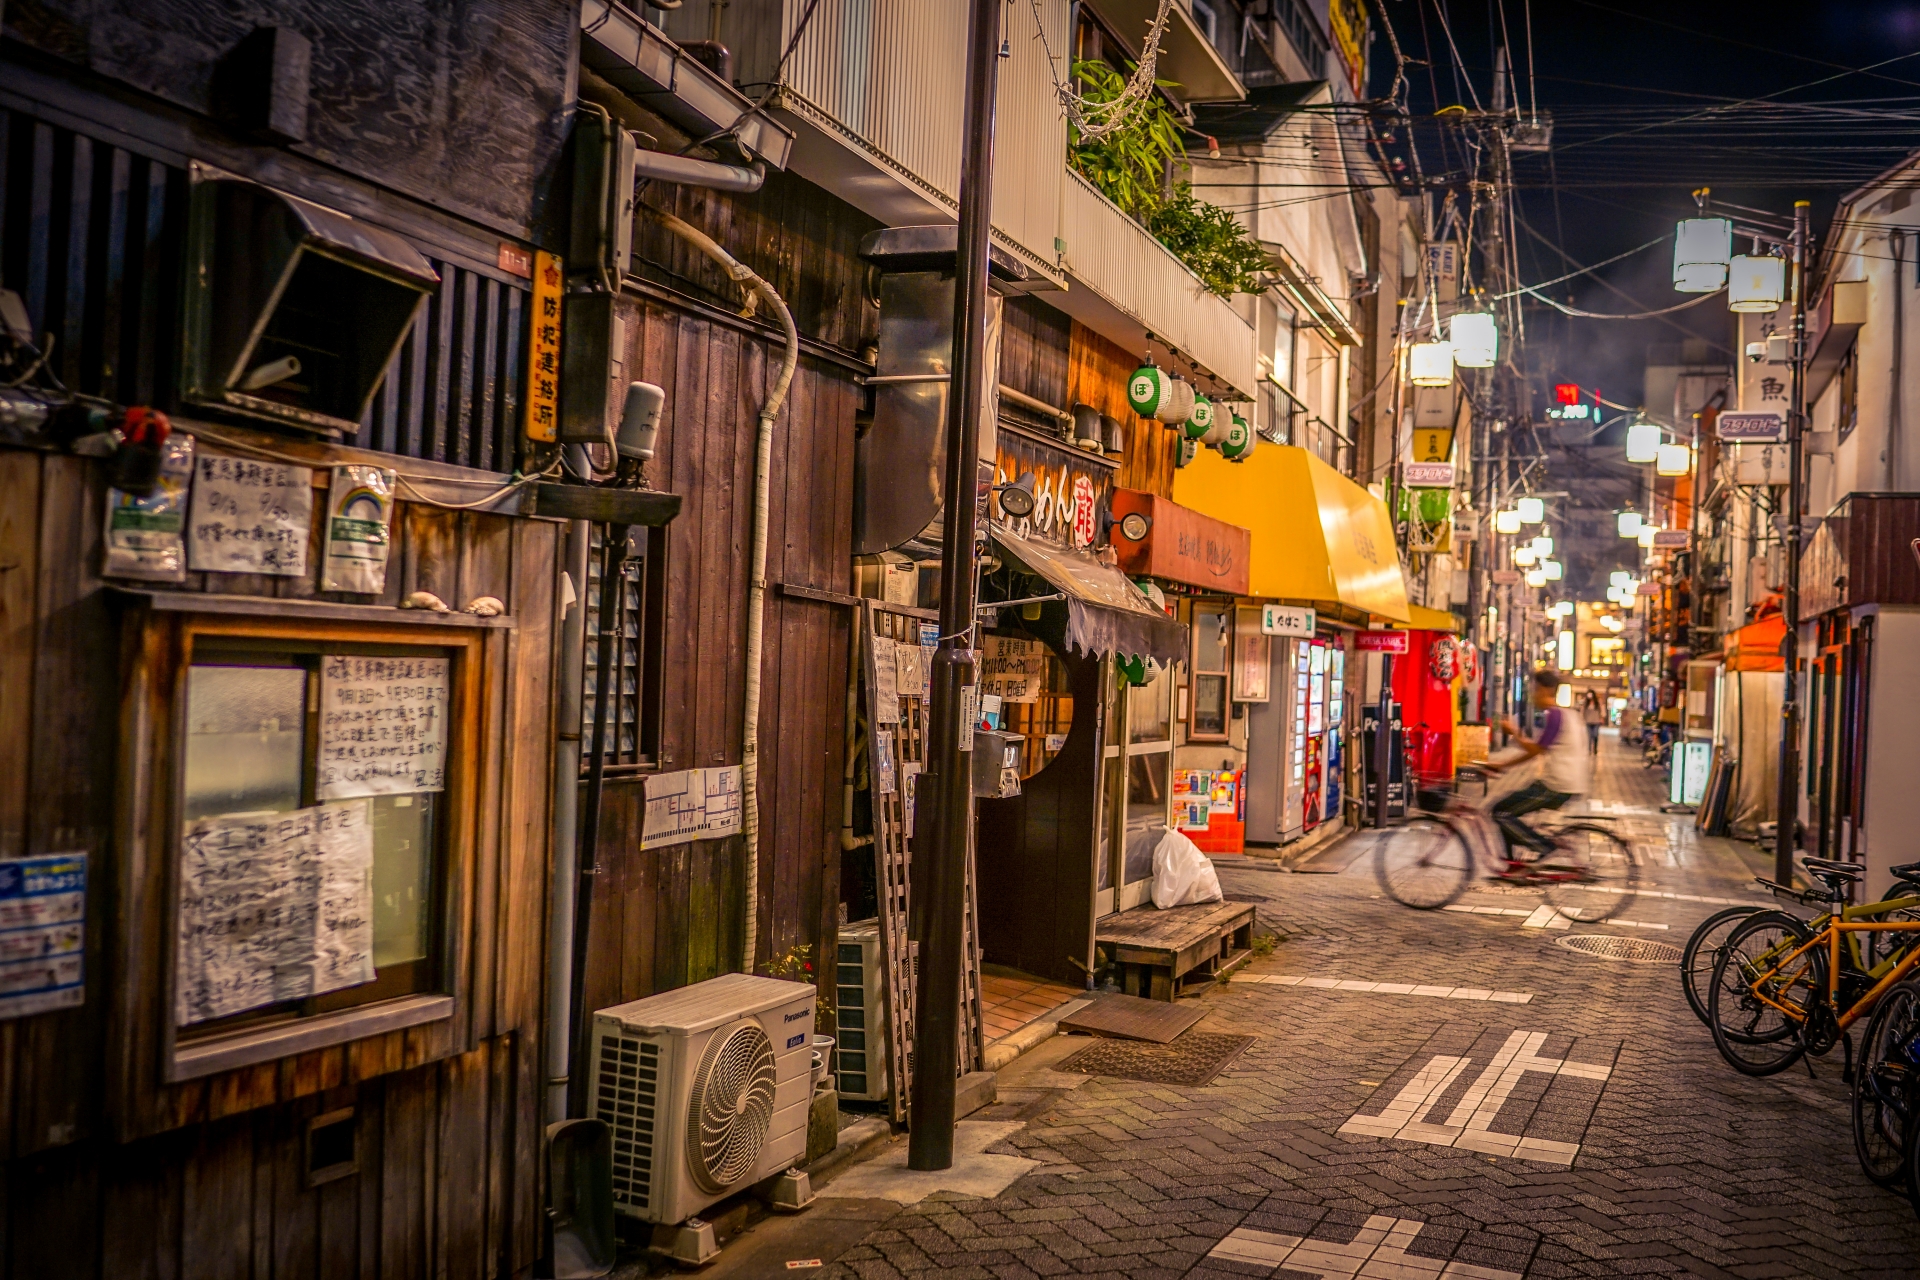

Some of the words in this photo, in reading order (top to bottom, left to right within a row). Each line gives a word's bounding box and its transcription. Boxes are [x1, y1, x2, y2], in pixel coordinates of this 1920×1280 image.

[540, 296, 558, 426] 防犯連絡所
[1760, 376, 1789, 402] 魚
[1277, 614, 1299, 628] たばこ
[998, 640, 1025, 656] 営業時間
[1007, 680, 1027, 697] 日曜日
[784, 1007, 810, 1023] Panasonic
[1337, 1029, 1613, 1166] 止
